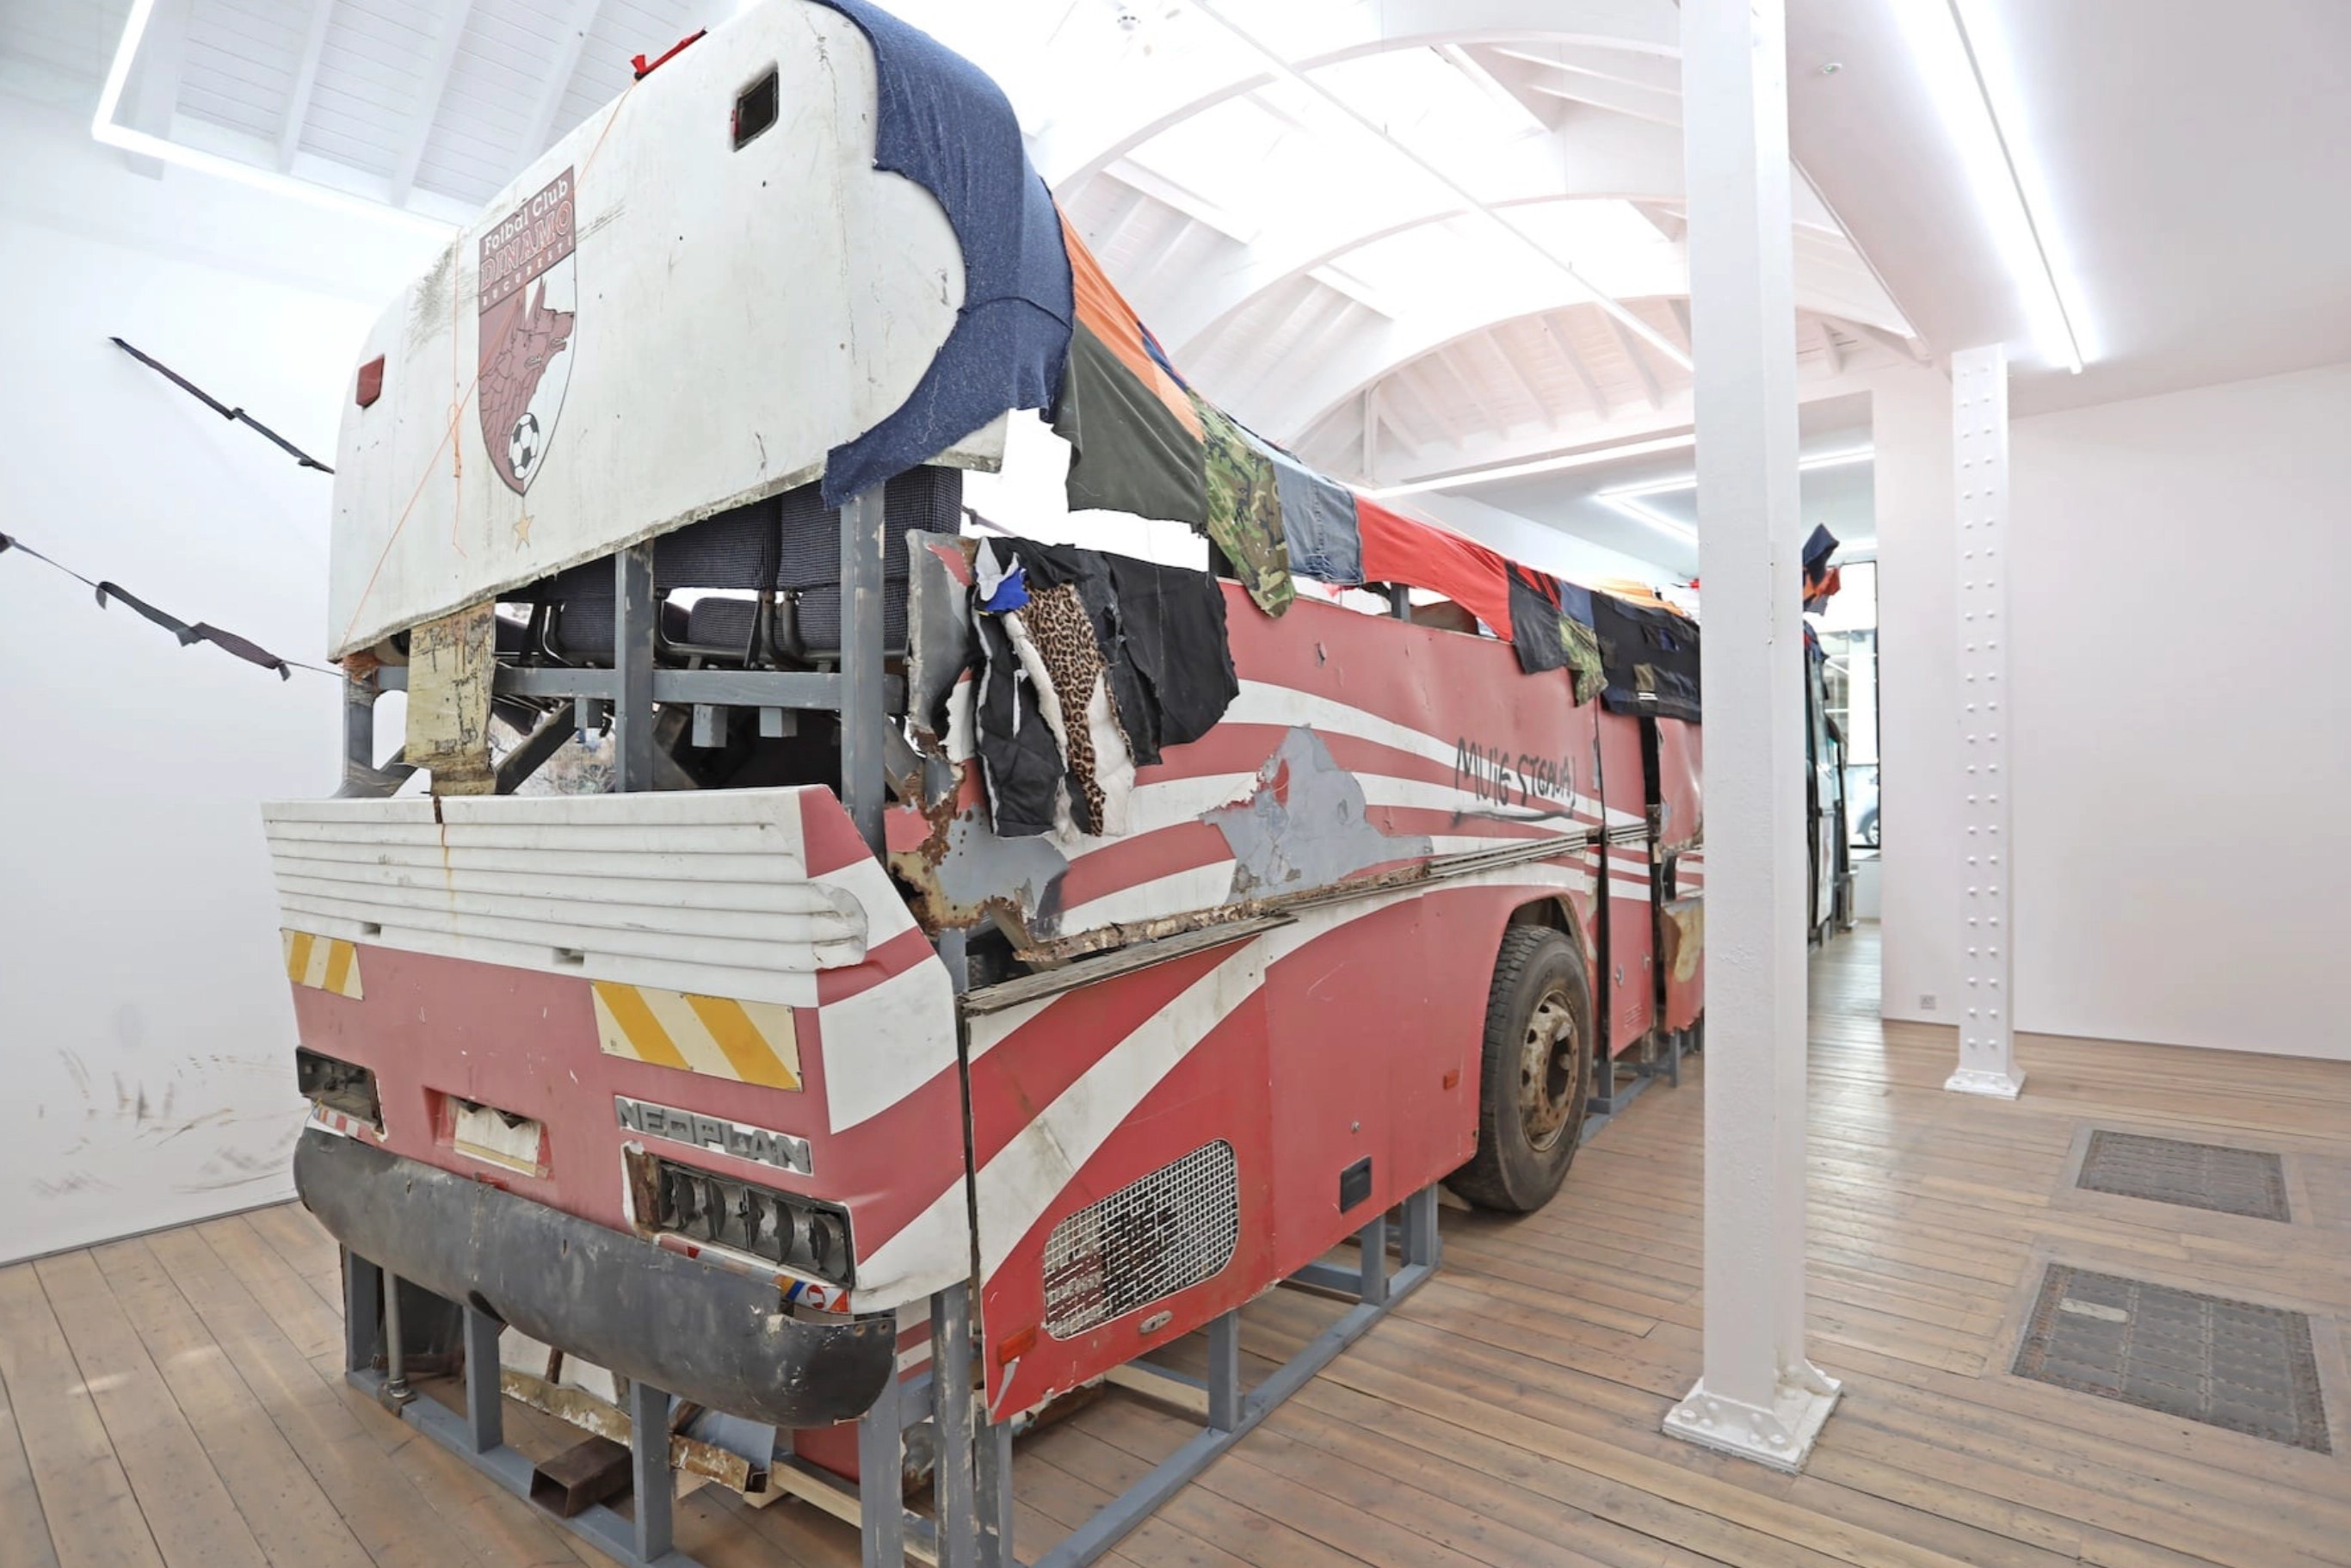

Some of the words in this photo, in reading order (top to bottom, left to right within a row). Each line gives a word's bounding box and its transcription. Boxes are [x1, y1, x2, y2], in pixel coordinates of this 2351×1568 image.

[480, 201, 573, 293] DINAMO
[484, 207, 529, 256] Fotbal
[532, 179, 569, 217] Club
[615, 1098, 811, 1174] NEOPLAN
